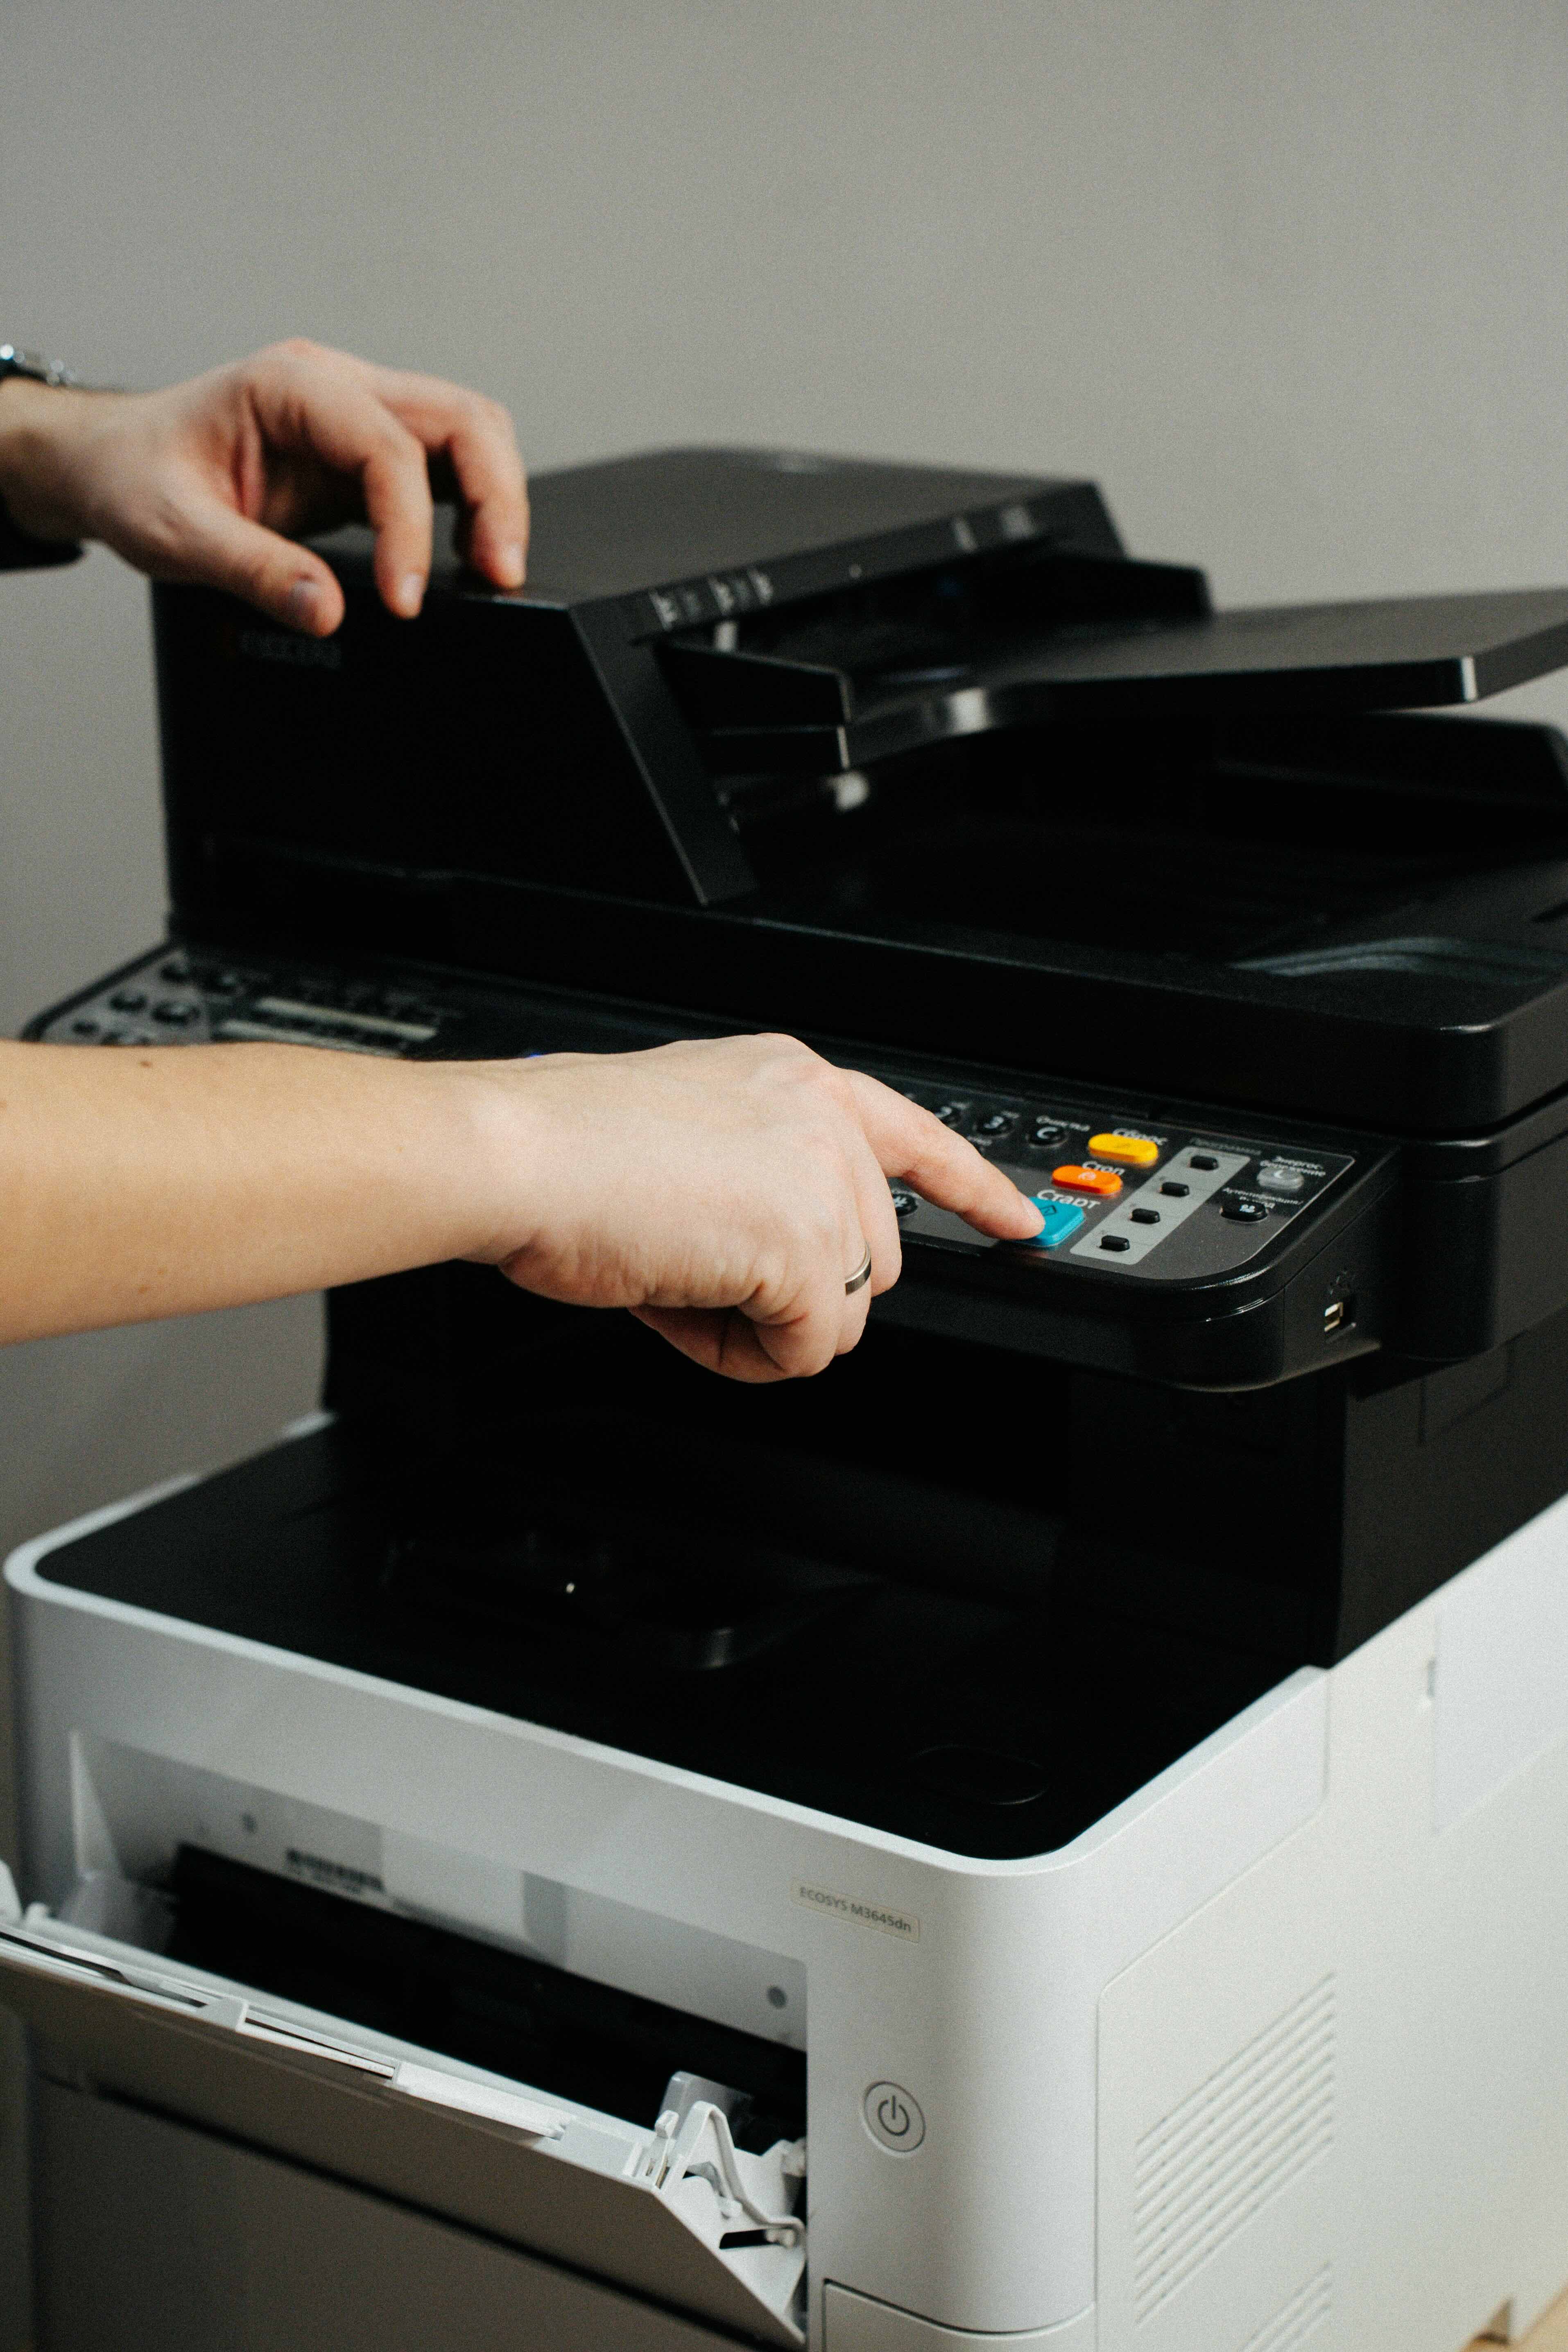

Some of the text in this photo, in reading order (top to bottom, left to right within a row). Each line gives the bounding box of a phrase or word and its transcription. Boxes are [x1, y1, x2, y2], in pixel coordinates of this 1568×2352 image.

[1082, 1160, 1125, 1176] Стоп
[1036, 1189, 1101, 1209] Старт
[799, 1886, 912, 1932] ECOSYS M3645dn
